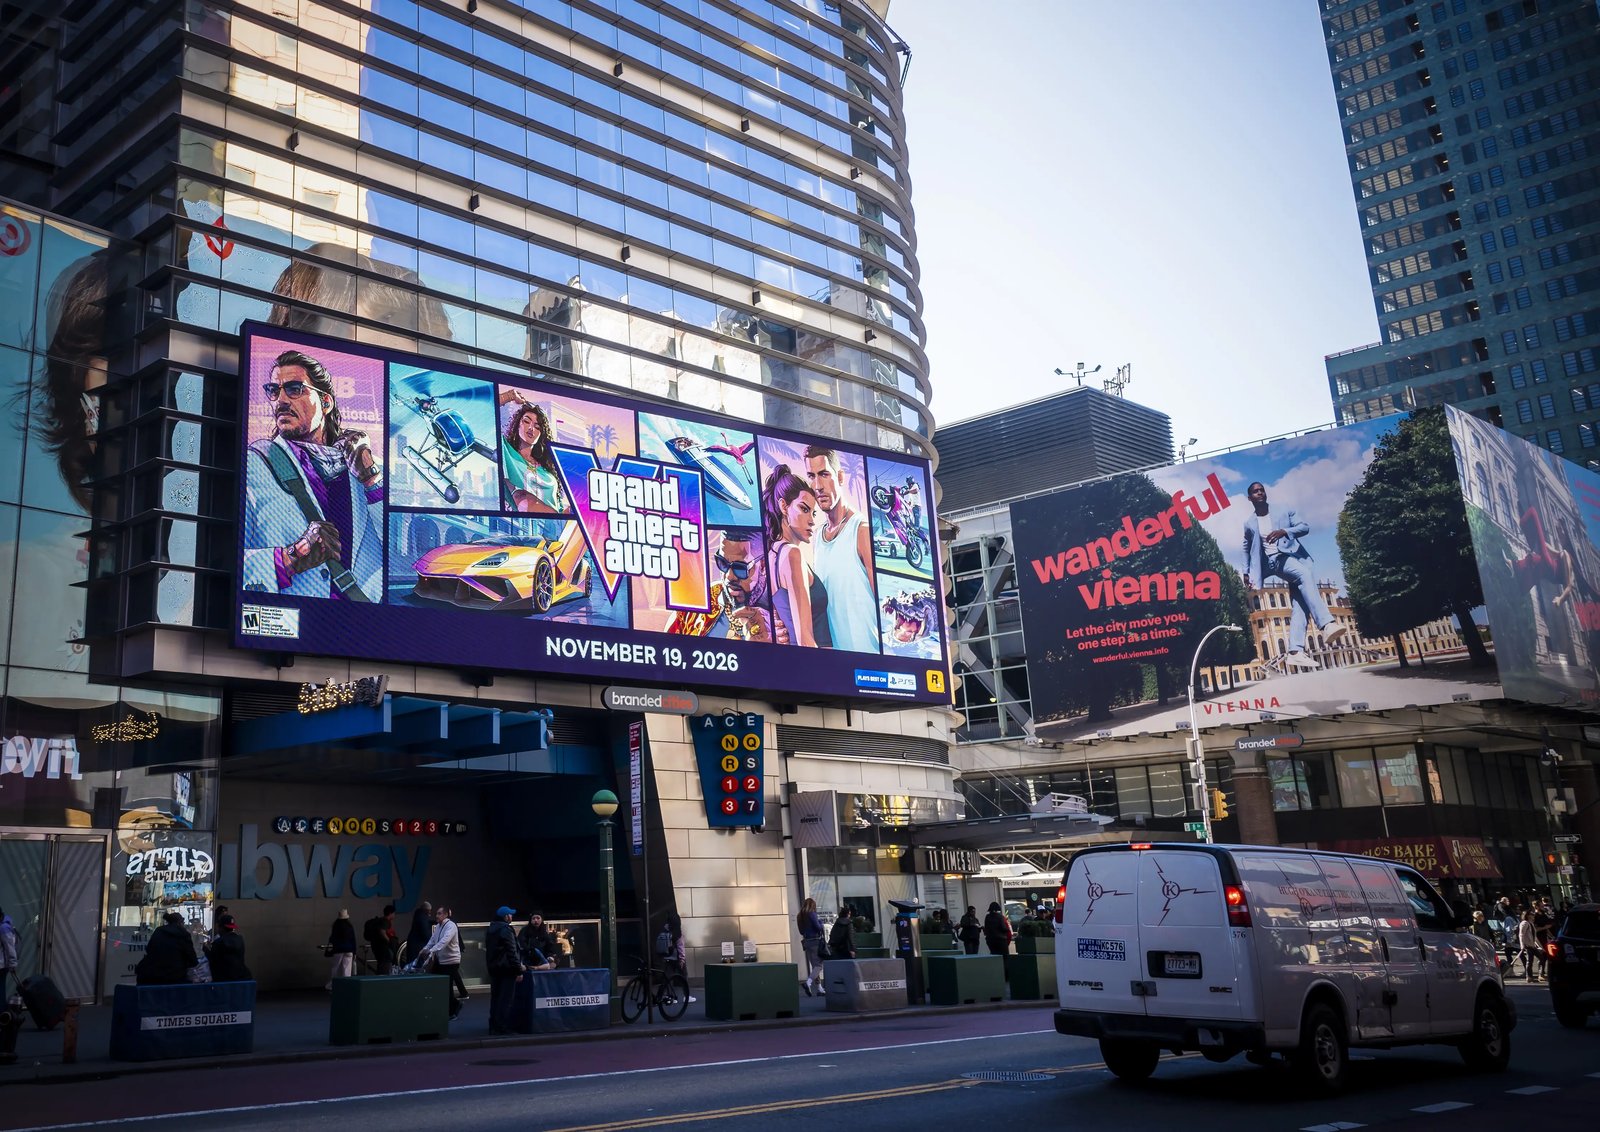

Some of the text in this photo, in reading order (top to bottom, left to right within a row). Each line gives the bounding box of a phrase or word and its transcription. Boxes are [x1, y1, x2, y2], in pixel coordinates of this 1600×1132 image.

[588, 470, 678, 514] grand
[607, 508, 700, 552] theft
[1031, 472, 1231, 585] wanderful
[605, 539, 680, 580] auto
[1077, 569, 1222, 611] vienna
[243, 613, 259, 628] M
[1066, 612, 1190, 640] Let the city move you,
[1077, 626, 1181, 650] one step at a time.
[545, 636, 739, 672] NOVEMBER 19, 2026
[1092, 646, 1169, 664] wanderful.vienna.info
[898, 678, 914, 686] PS5
[1204, 696, 1281, 715] VIENNA
[704, 715, 755, 728] A C E
[725, 737, 757, 748] N Q
[726, 757, 756, 768] R S
[726, 778, 756, 790] 1 2
[726, 800, 756, 811] 3 7
[280, 819, 290, 831] A
[349, 820, 358, 832] Q
[365, 820, 374, 832] R
[382, 820, 389, 832] S
[398, 821, 404, 832] 1
[413, 821, 421, 832] 2
[429, 822, 436, 833] 3
[444, 823, 451, 833] 7
[1393, 844, 1436, 858] BAKE
[941, 850, 967, 871] TIMES
[1394, 857, 1437, 871] HOP
[1232, 930, 1247, 939] 576
[1101, 941, 1124, 951] KC576
[863, 979, 900, 990] TIMES SQUARE
[1209, 986, 1233, 994] GMC
[546, 995, 601, 1007] TIMES SQUARE
[156, 1013, 238, 1028] TIMES SQUARE
